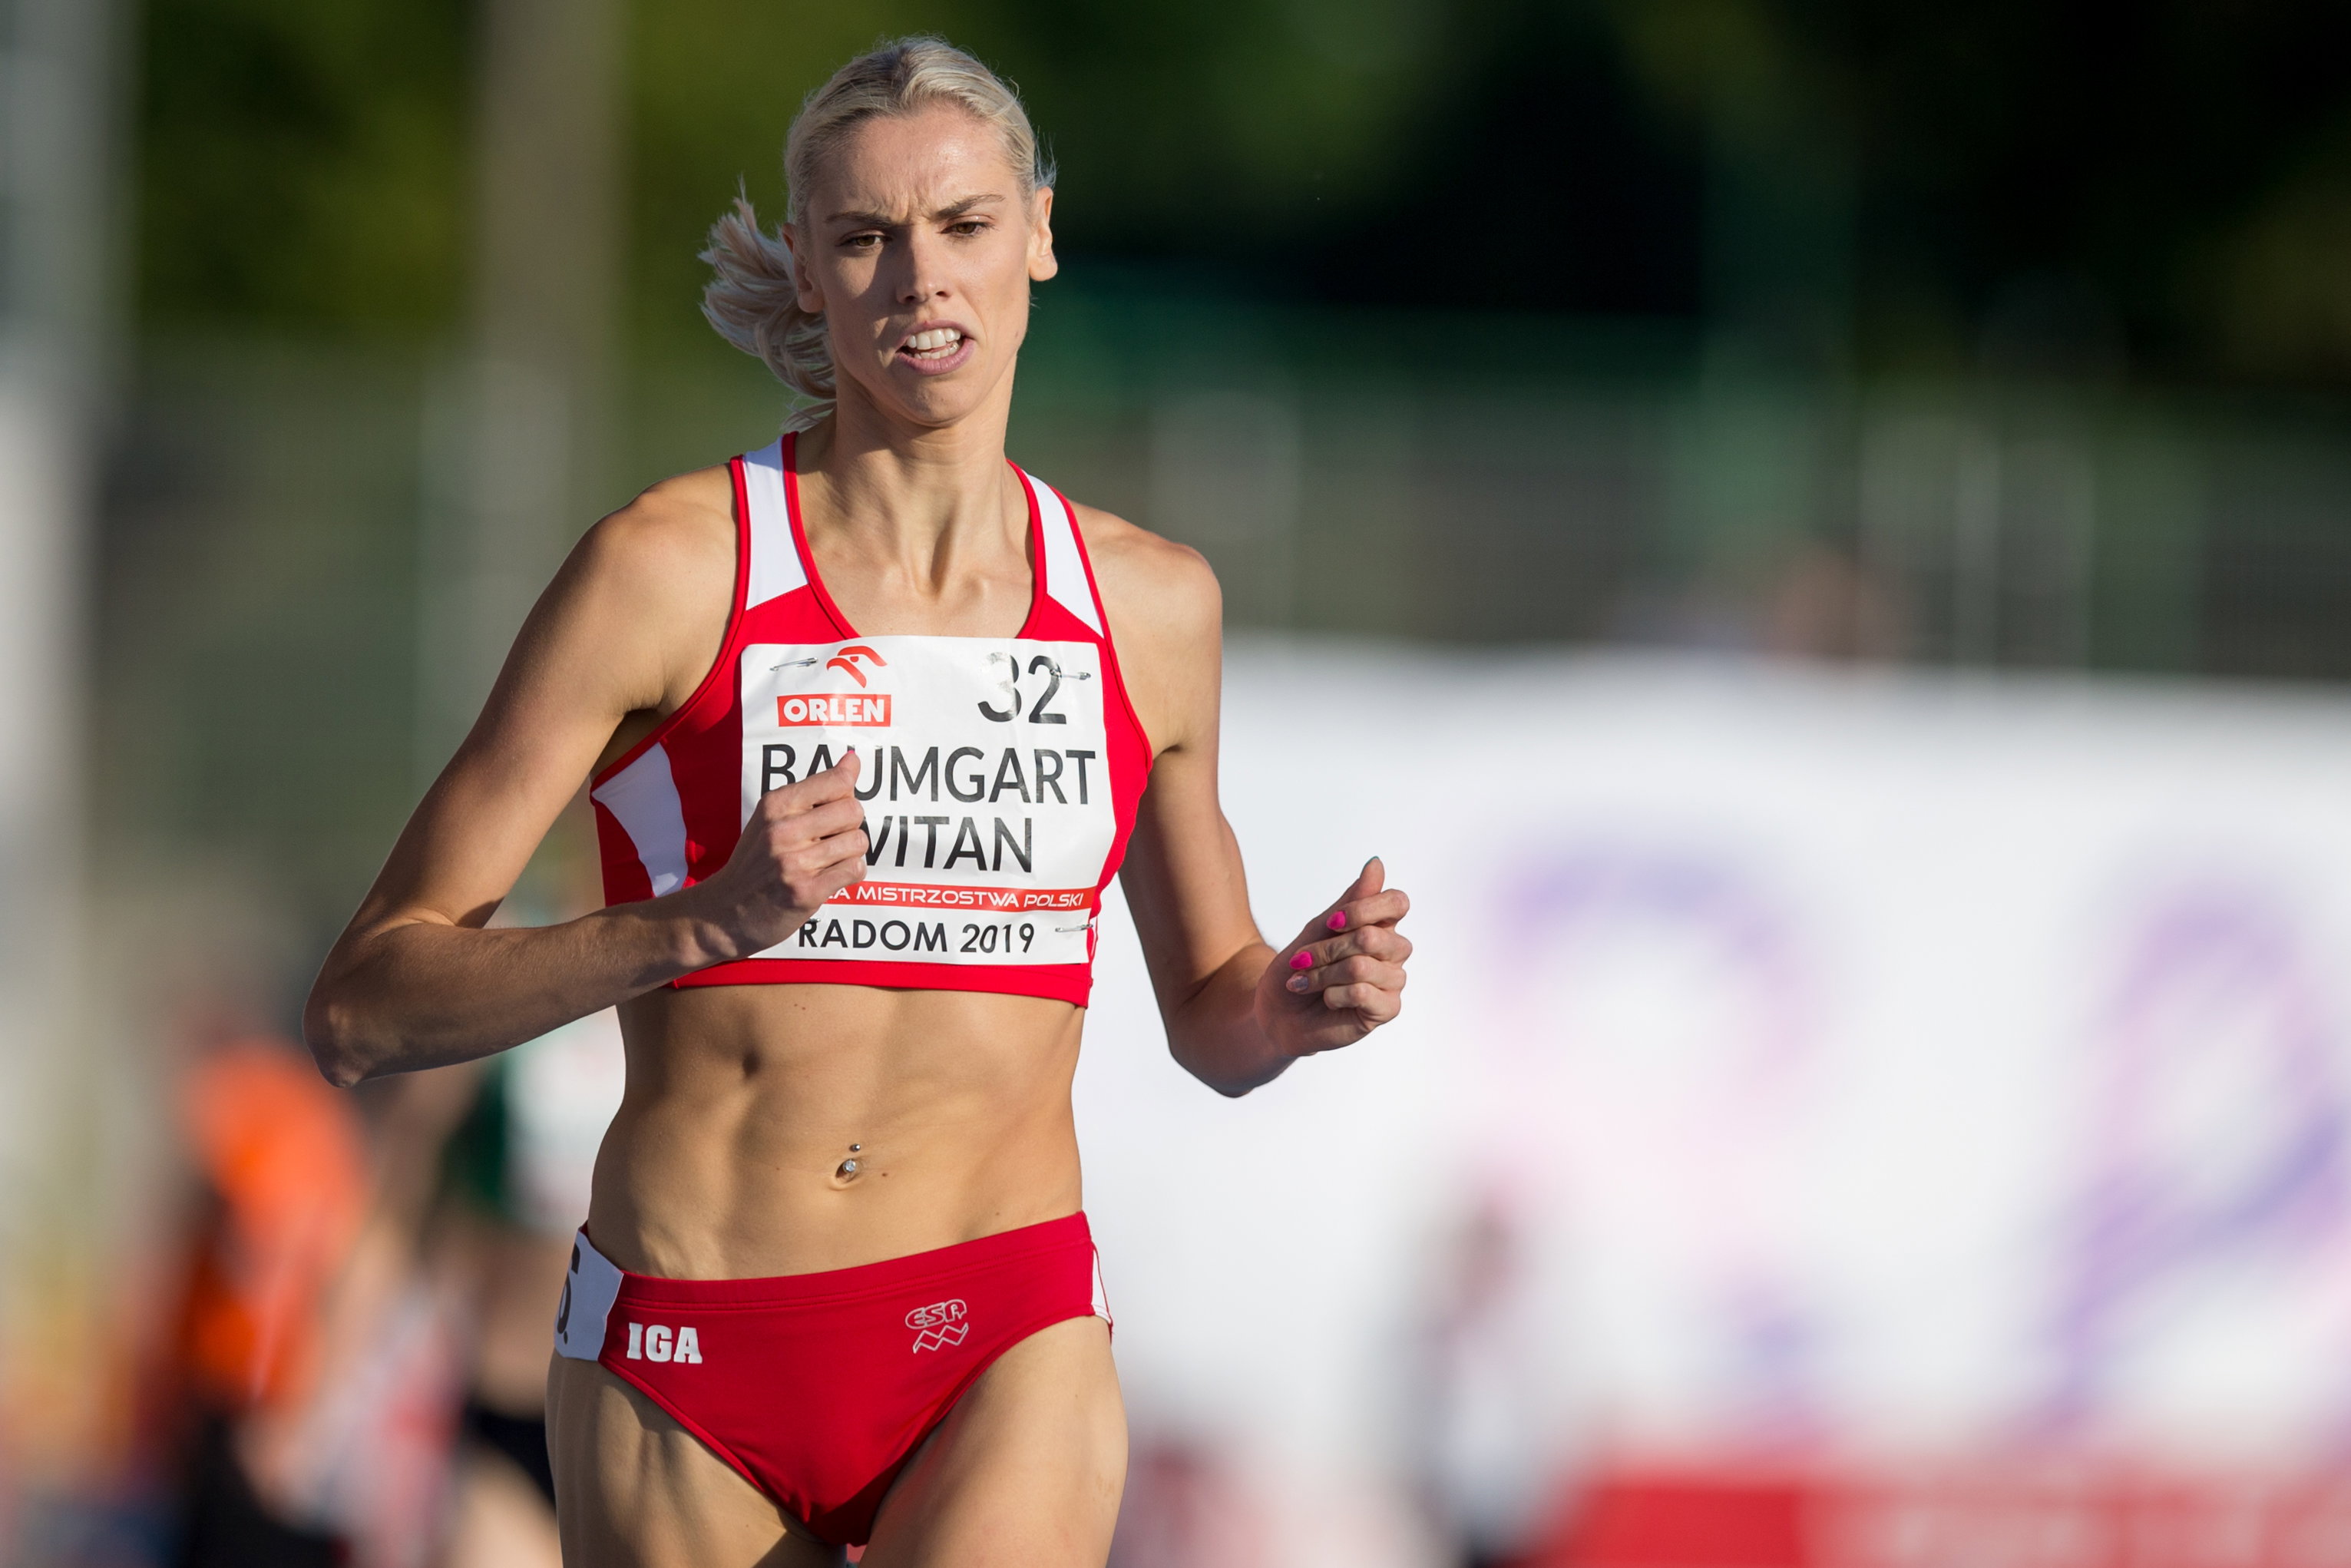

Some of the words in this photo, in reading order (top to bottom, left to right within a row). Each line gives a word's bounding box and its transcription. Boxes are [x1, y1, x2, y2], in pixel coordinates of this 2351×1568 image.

[977, 652, 1066, 724] 32
[783, 698, 885, 723] ORLEN
[760, 743, 1096, 804] BAUMGART
[856, 885, 1020, 908] MISTRZOSTWA
[1023, 893, 1084, 908] POLSKI
[799, 919, 947, 952] RADOM
[960, 923, 1035, 954] 2019
[627, 1322, 703, 1364] IGA
